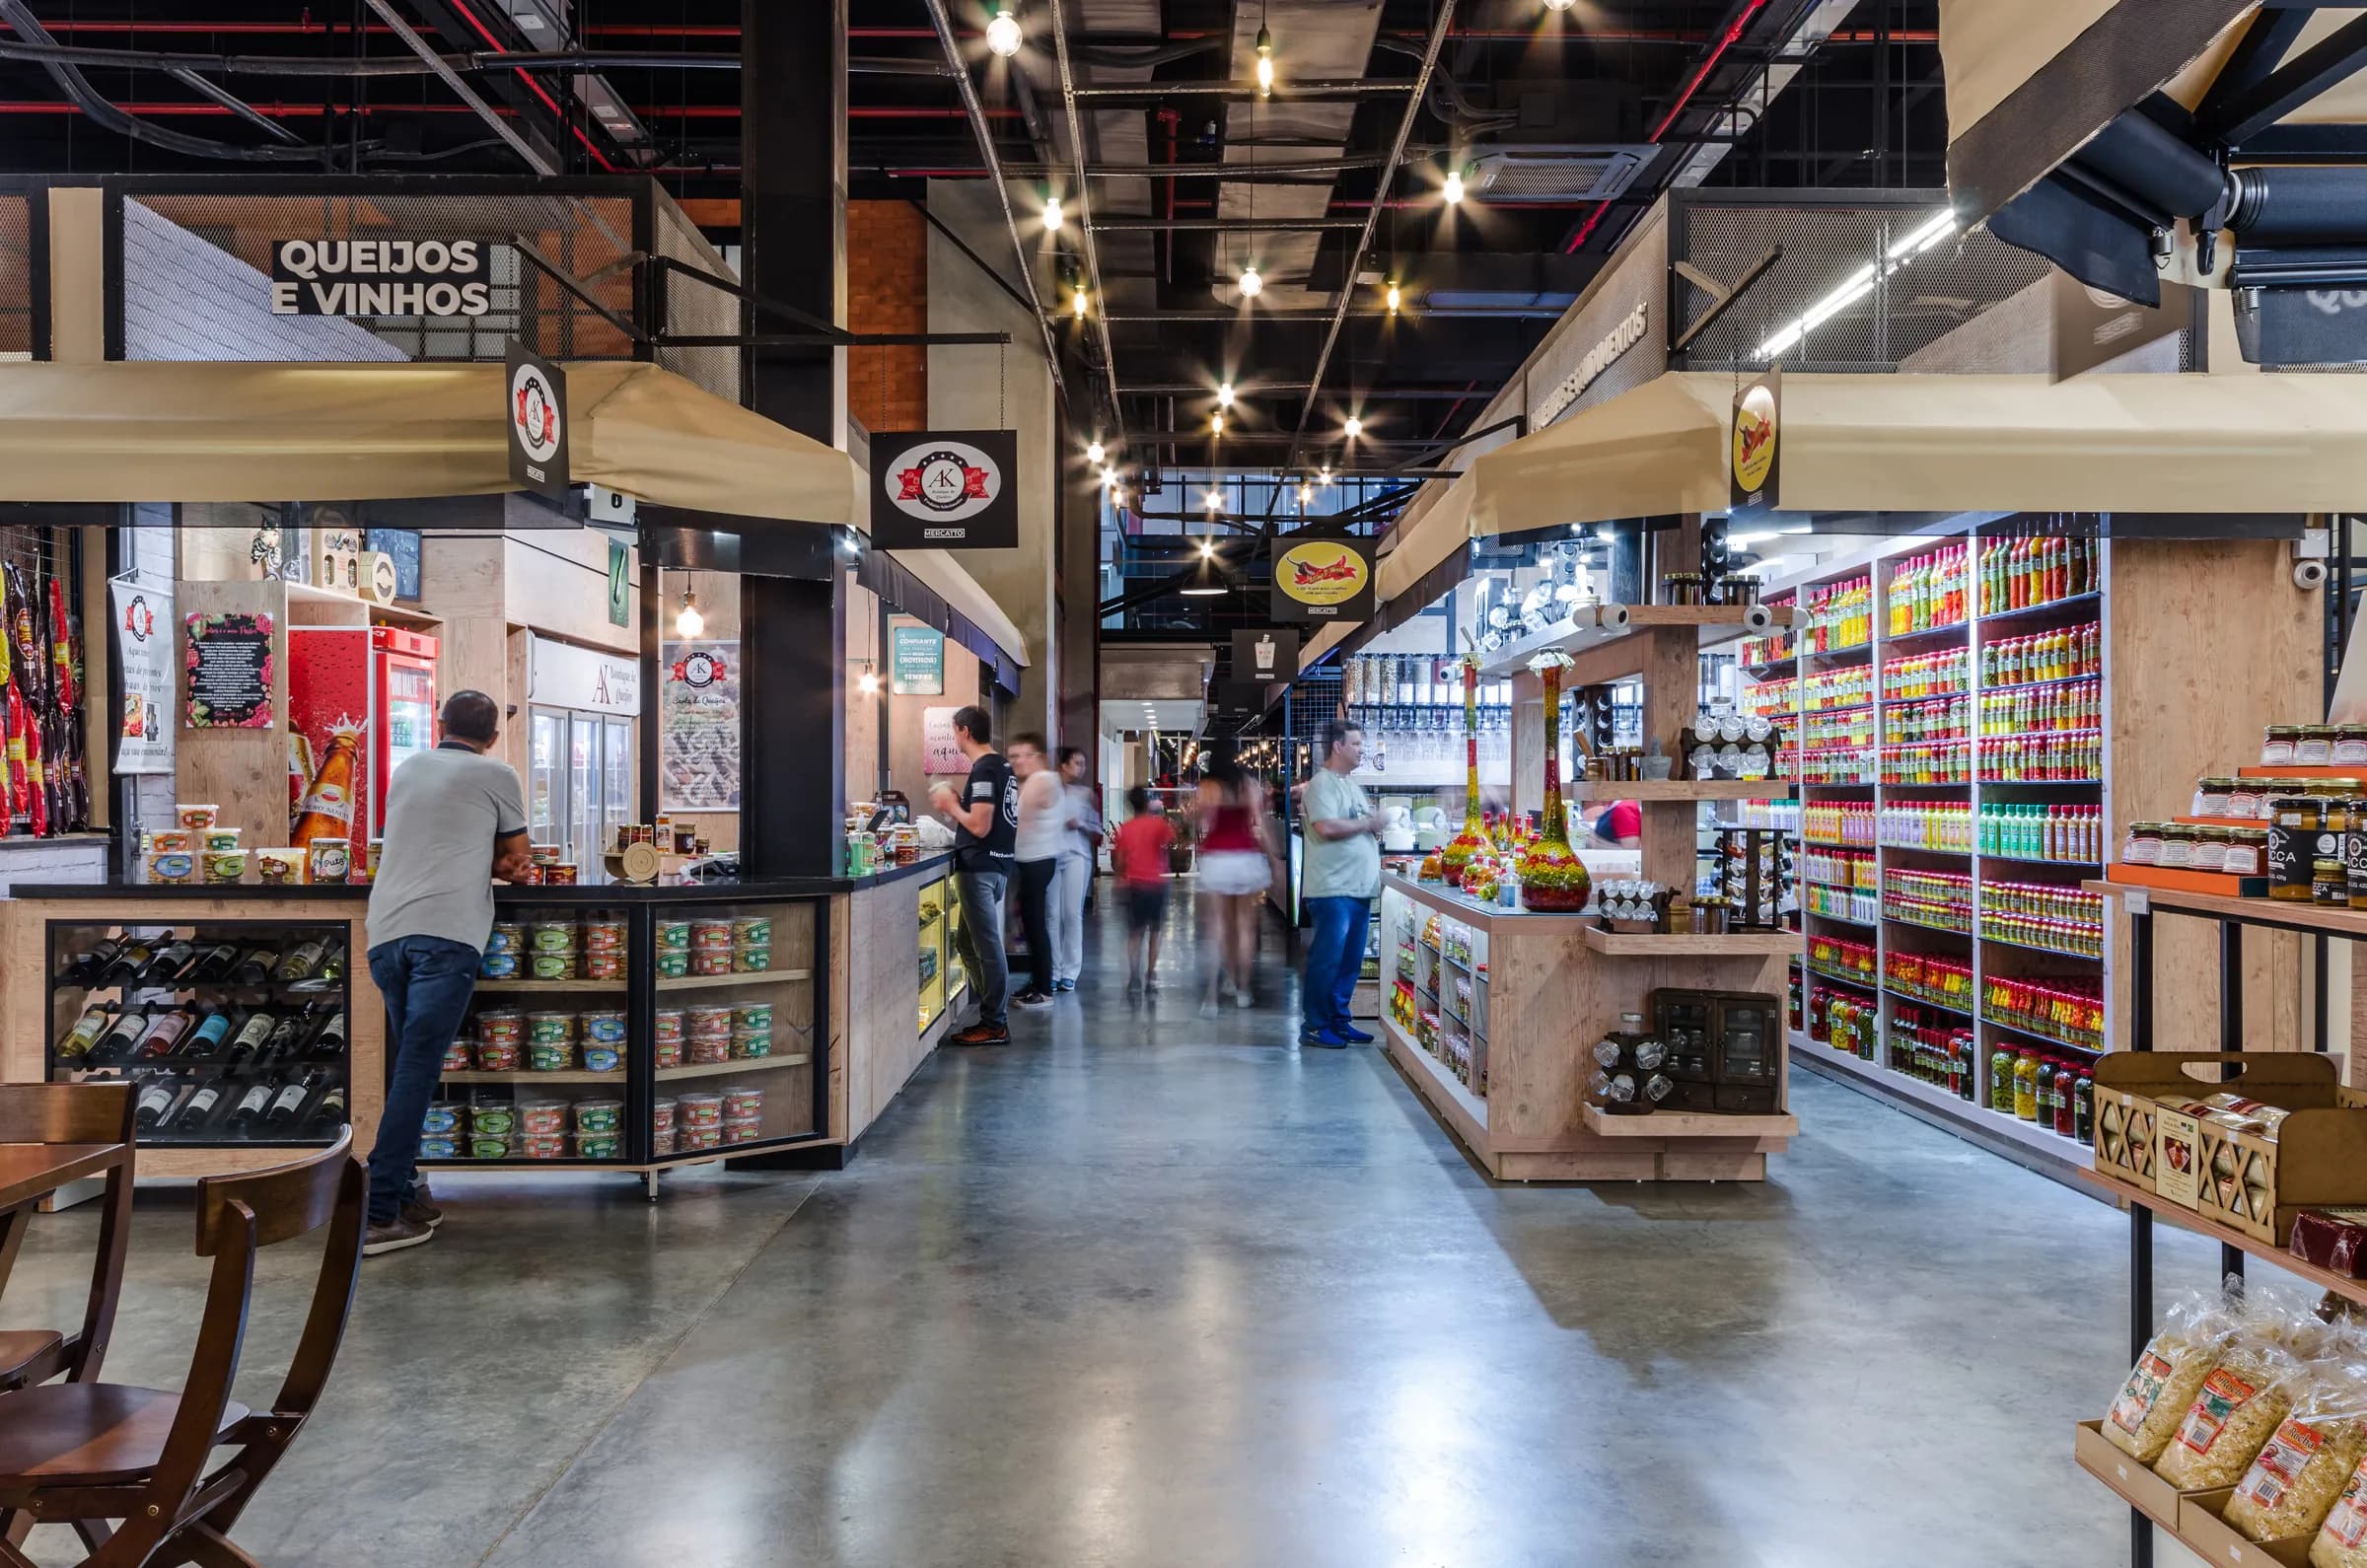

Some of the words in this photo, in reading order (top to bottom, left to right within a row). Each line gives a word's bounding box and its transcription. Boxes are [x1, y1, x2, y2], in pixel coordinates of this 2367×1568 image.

[280, 240, 479, 280] QUEIJOS
[272, 282, 299, 315] E
[311, 282, 489, 316] VINHOS
[928, 468, 957, 488] AK
[925, 529, 964, 537] MERCATTO
[592, 664, 610, 704] AK
